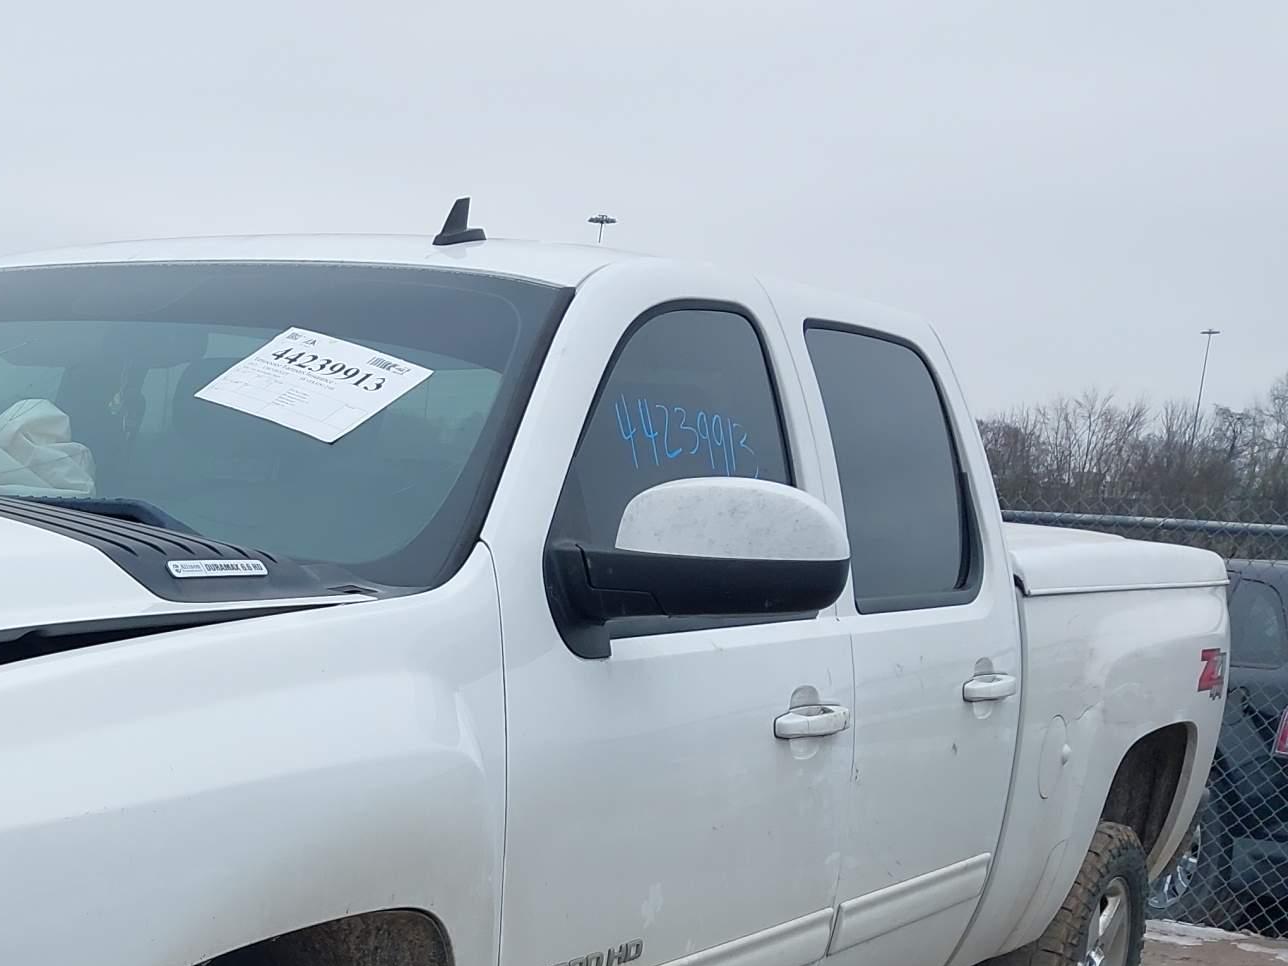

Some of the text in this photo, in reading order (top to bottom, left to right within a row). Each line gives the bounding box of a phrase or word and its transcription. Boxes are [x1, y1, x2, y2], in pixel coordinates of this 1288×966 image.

[272, 347, 386, 391] 44239913
[615, 393, 758, 478] 44239913
[204, 563, 241, 572] DURAMAX
